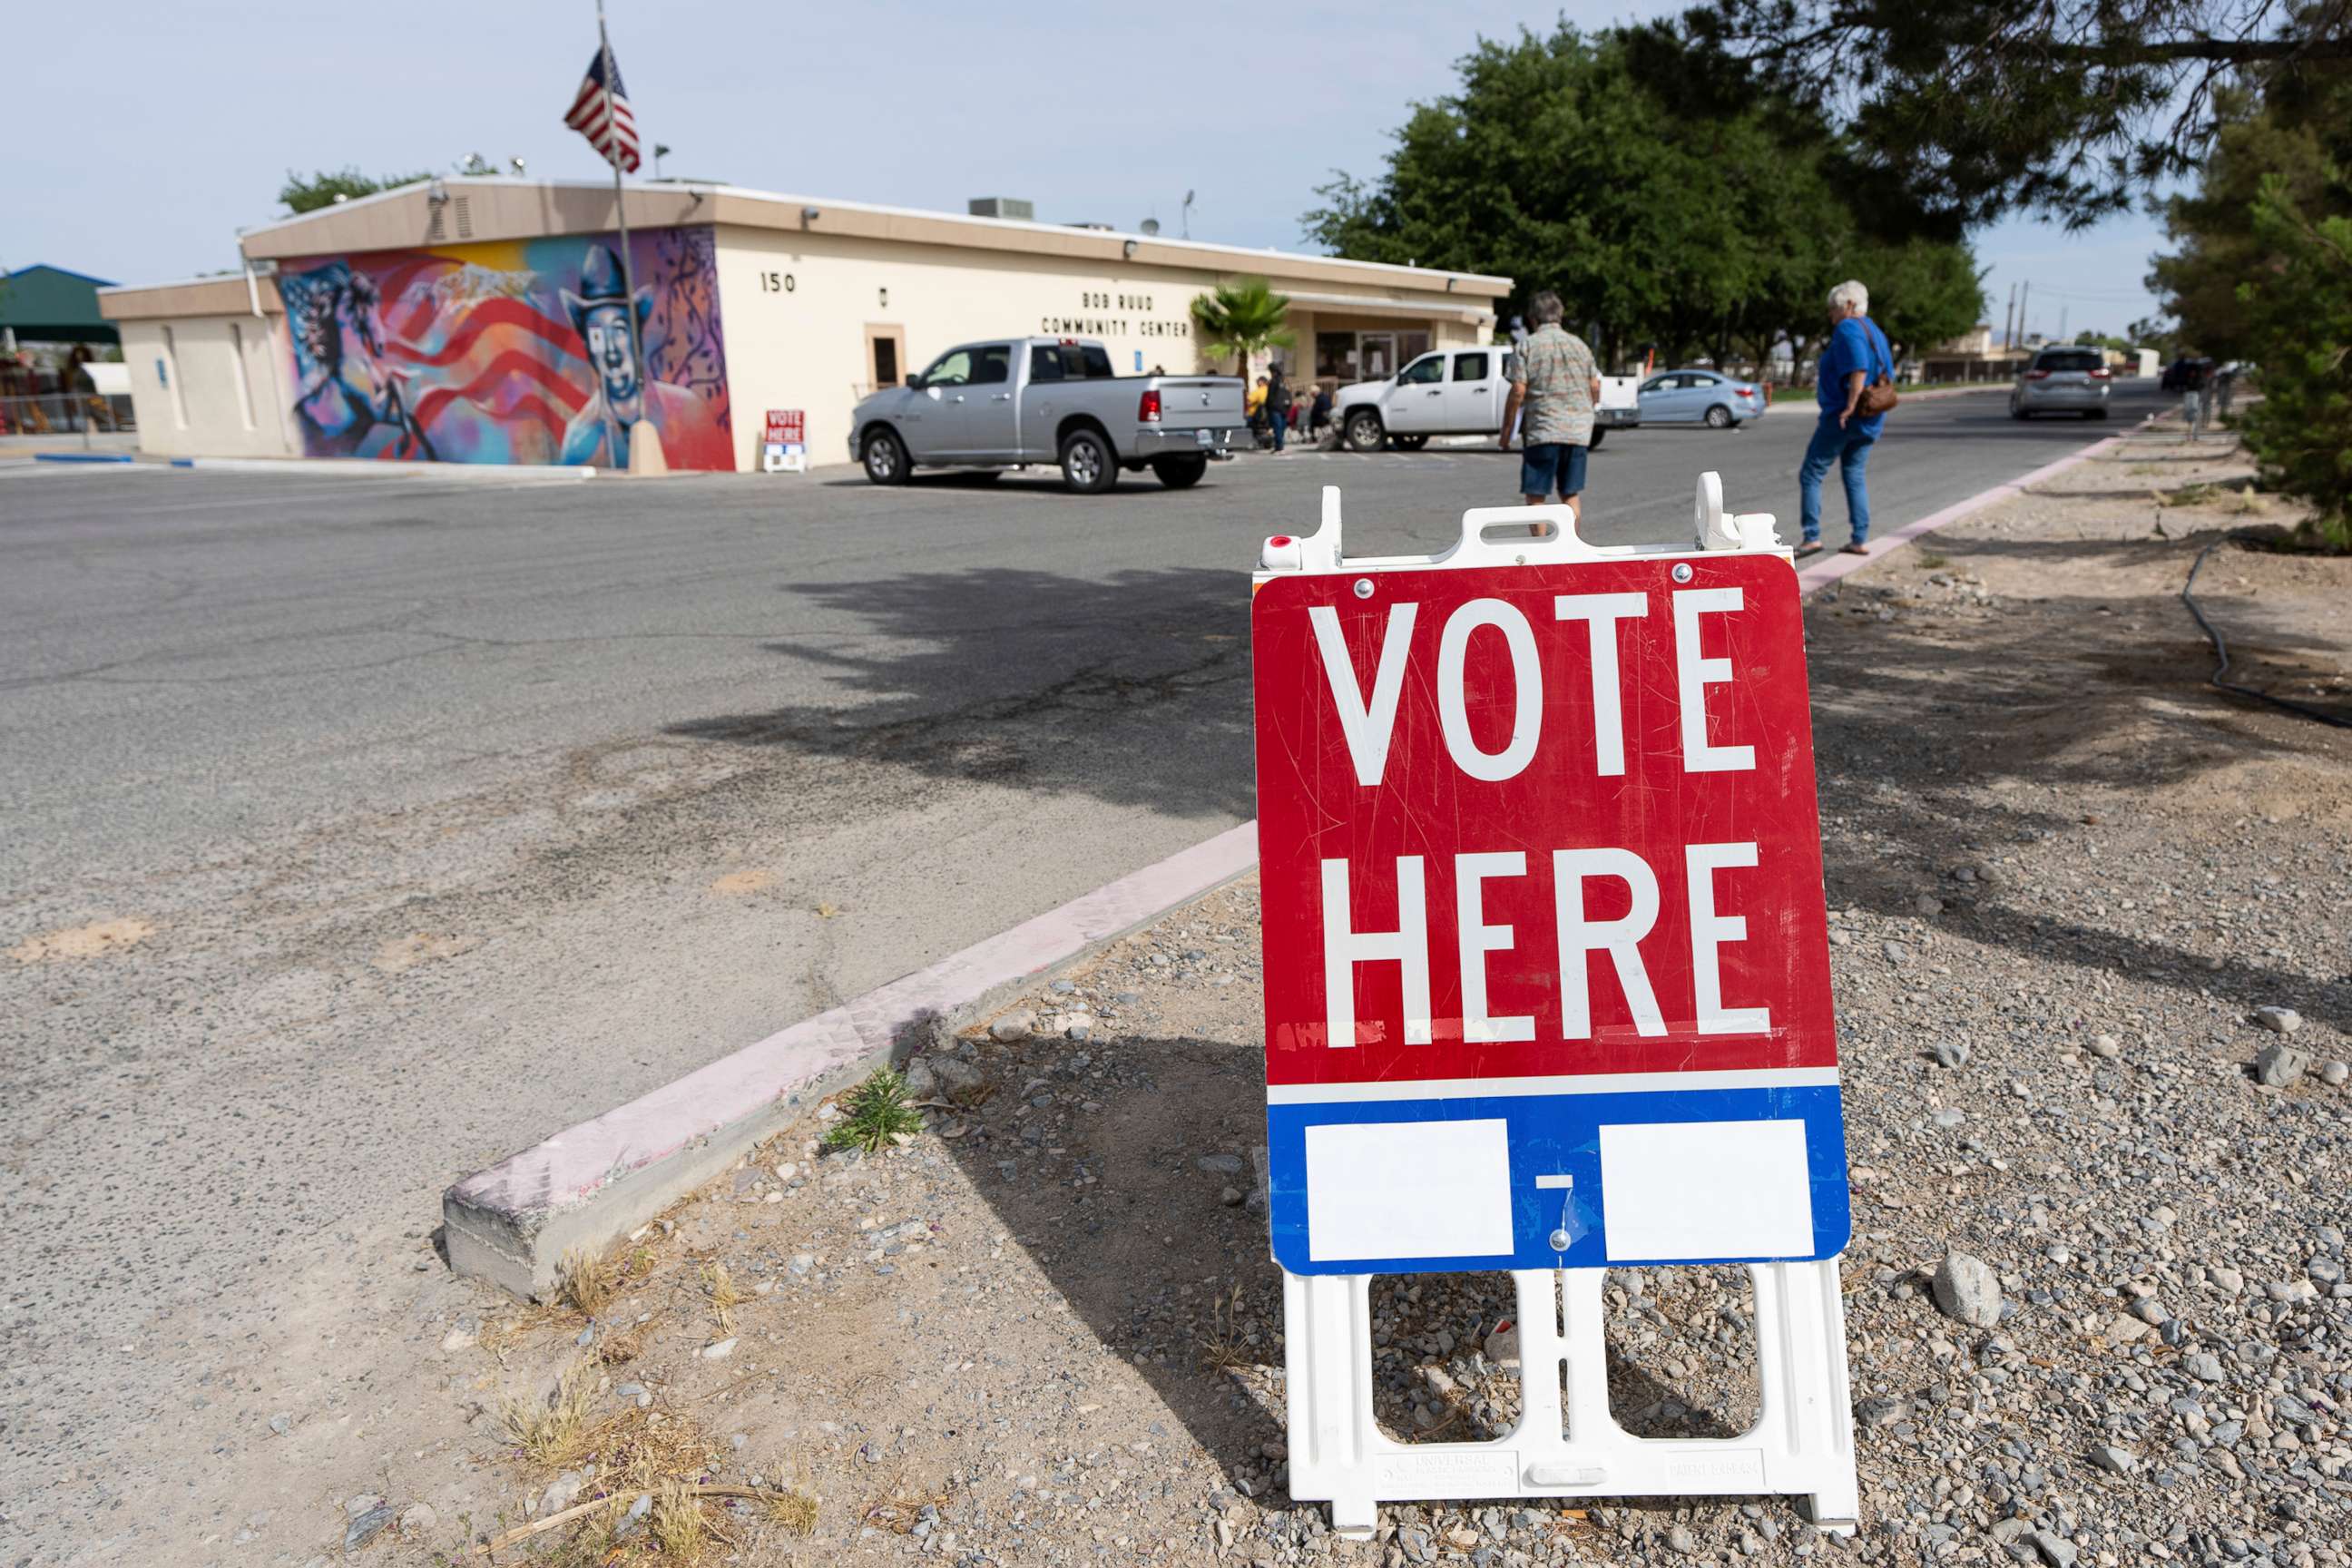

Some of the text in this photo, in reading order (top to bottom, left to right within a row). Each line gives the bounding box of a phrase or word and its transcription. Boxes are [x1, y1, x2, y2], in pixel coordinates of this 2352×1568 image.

[761, 271, 795, 291] 150
[1083, 292, 1109, 309] BOB
[1042, 318, 1189, 337] COMMUNITY CENTER
[769, 411, 800, 426] VOTE
[769, 427, 800, 442] HERE
[1308, 587, 1756, 786] VOTE
[1321, 842, 1771, 1047] HERE
